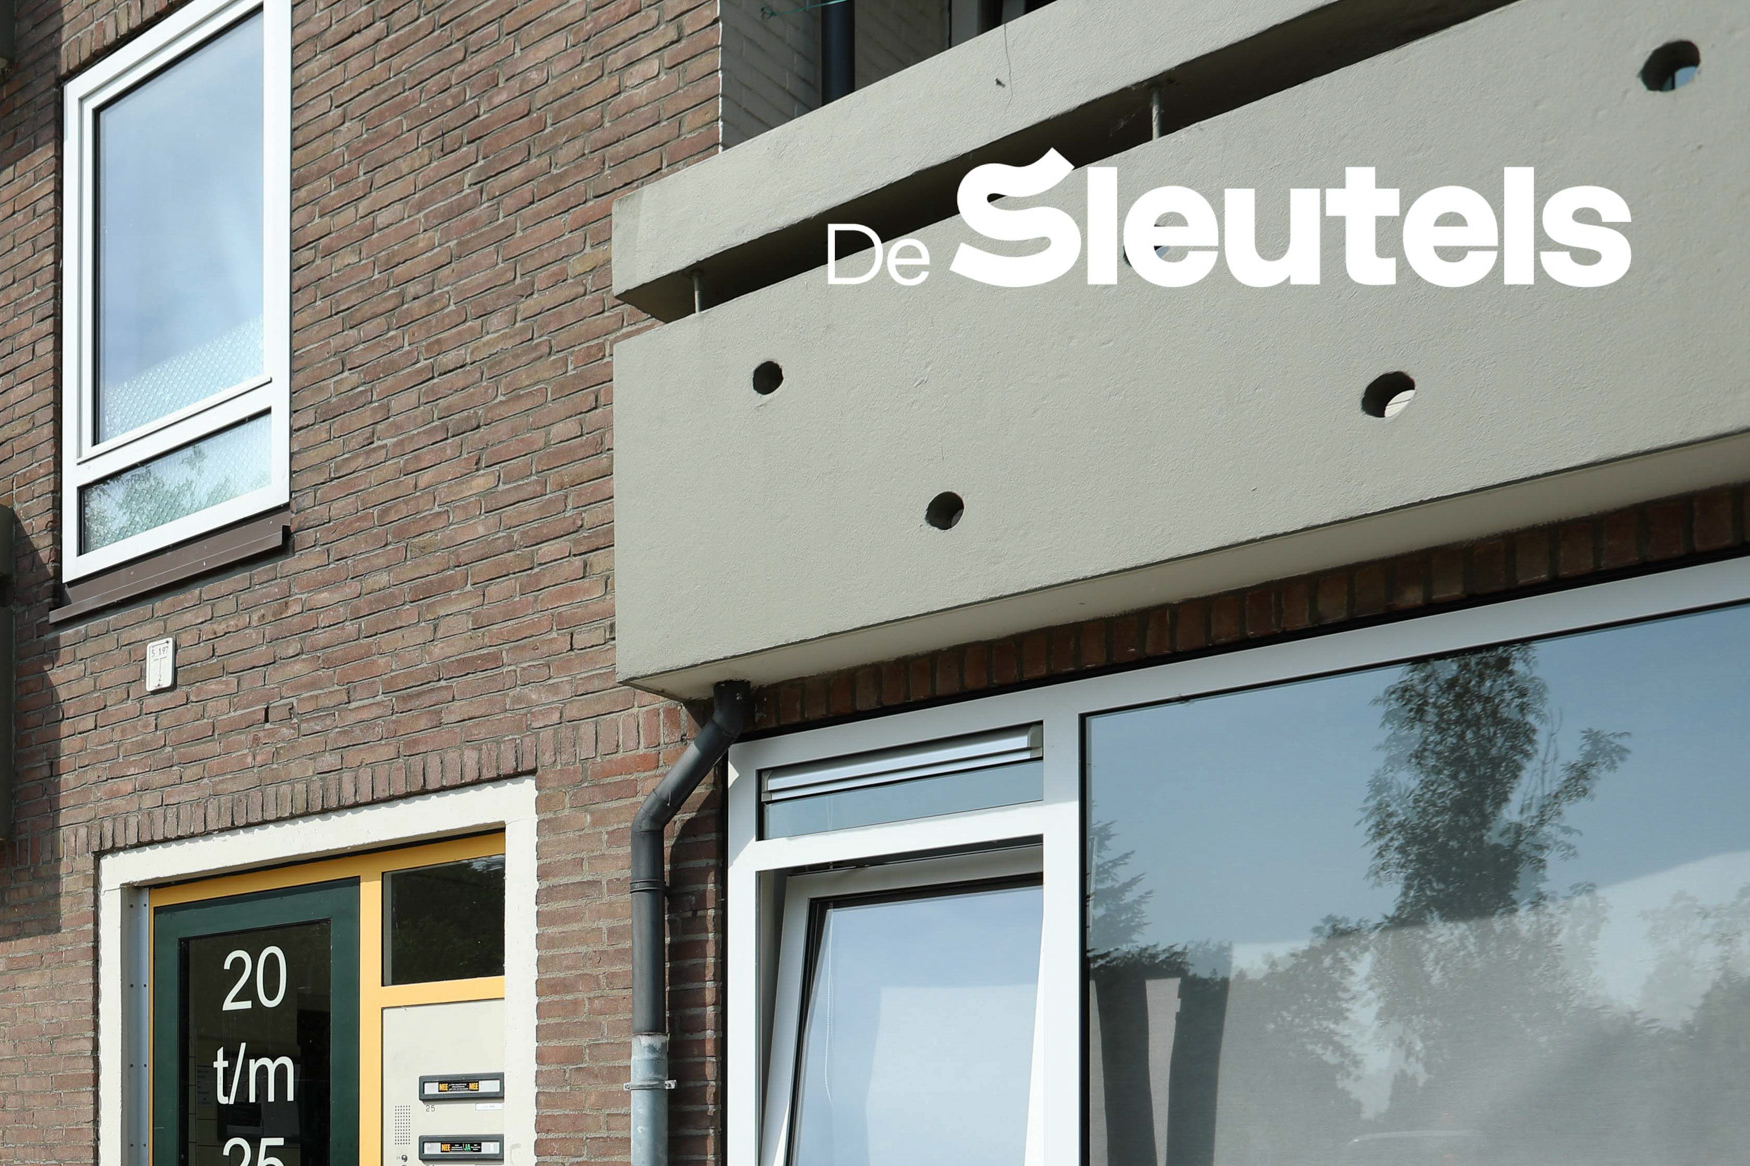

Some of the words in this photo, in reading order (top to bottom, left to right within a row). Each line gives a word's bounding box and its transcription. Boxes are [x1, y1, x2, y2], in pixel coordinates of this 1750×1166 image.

[222, 945, 288, 1011] 20
[213, 1042, 295, 1105] t/m
[439, 1083, 448, 1091] NEE
[469, 1082, 479, 1090] NEE
[425, 1104, 436, 1112] 25
[441, 1143, 451, 1151] NEE
[463, 1143, 471, 1152] JA
